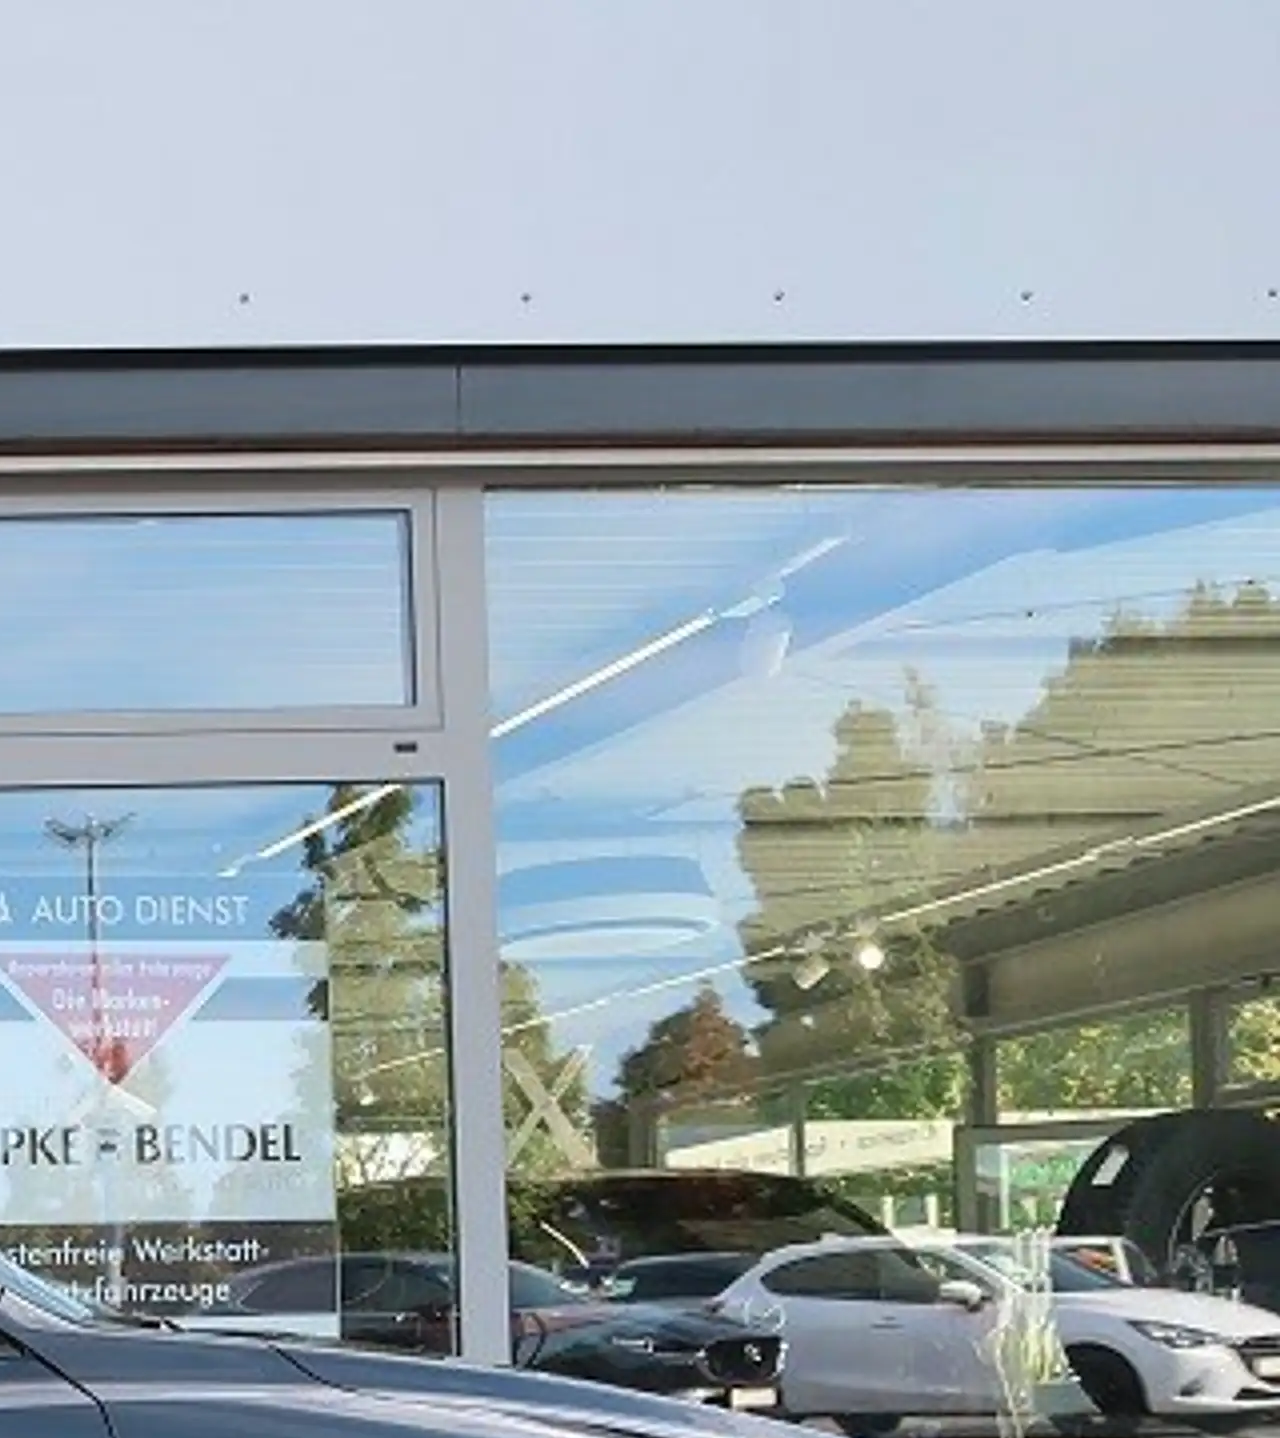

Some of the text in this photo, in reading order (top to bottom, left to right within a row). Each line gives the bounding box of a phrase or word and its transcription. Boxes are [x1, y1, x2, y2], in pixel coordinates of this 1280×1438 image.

[30, 895, 125, 926] AUTO
[134, 894, 250, 926] DIENST
[134, 1122, 302, 1165] BENDEL
[0, 1236, 124, 1266] stenfreie
